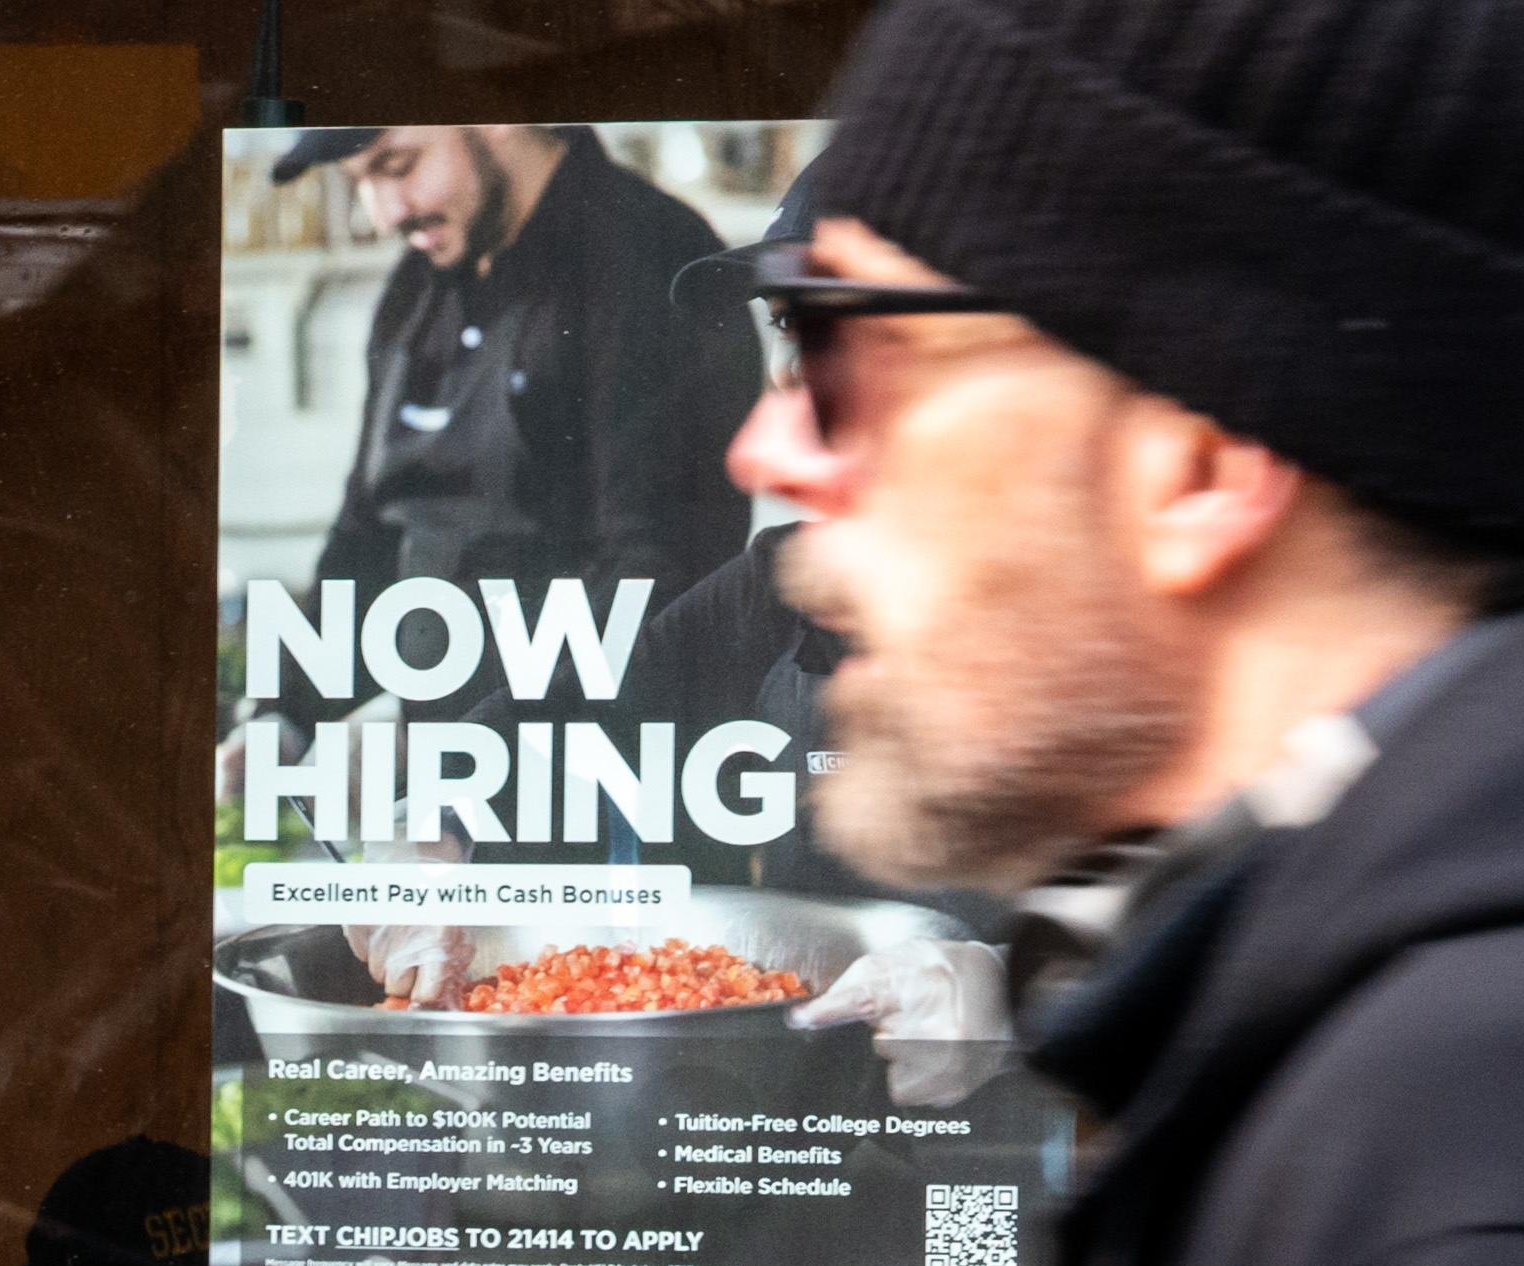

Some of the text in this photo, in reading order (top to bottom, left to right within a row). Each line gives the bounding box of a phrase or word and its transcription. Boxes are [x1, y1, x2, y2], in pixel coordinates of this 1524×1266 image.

[246, 577, 655, 701] NOW
[243, 720, 797, 846] HIRING
[272, 882, 662, 907] Excellent Pay with Cash Bonuses
[269, 1060, 634, 1085] Real Career, Amazing Benefits
[283, 1108, 592, 1130] Career Path to $100K Potential
[674, 1112, 971, 1138] Tuition-Free College Degrees
[283, 1133, 334, 1152] Total
[338, 1134, 482, 1155] Compensation
[486, 1135, 506, 1153] in
[537, 1136, 593, 1155] Years
[674, 1144, 842, 1165] Medical Benefits
[283, 1171, 578, 1196] 401K with Employer Matching
[673, 1175, 852, 1197] Flexible Schedule
[265, 1224, 704, 1252] TEXT CHIPJOBS TO 21414 TO APPLY
